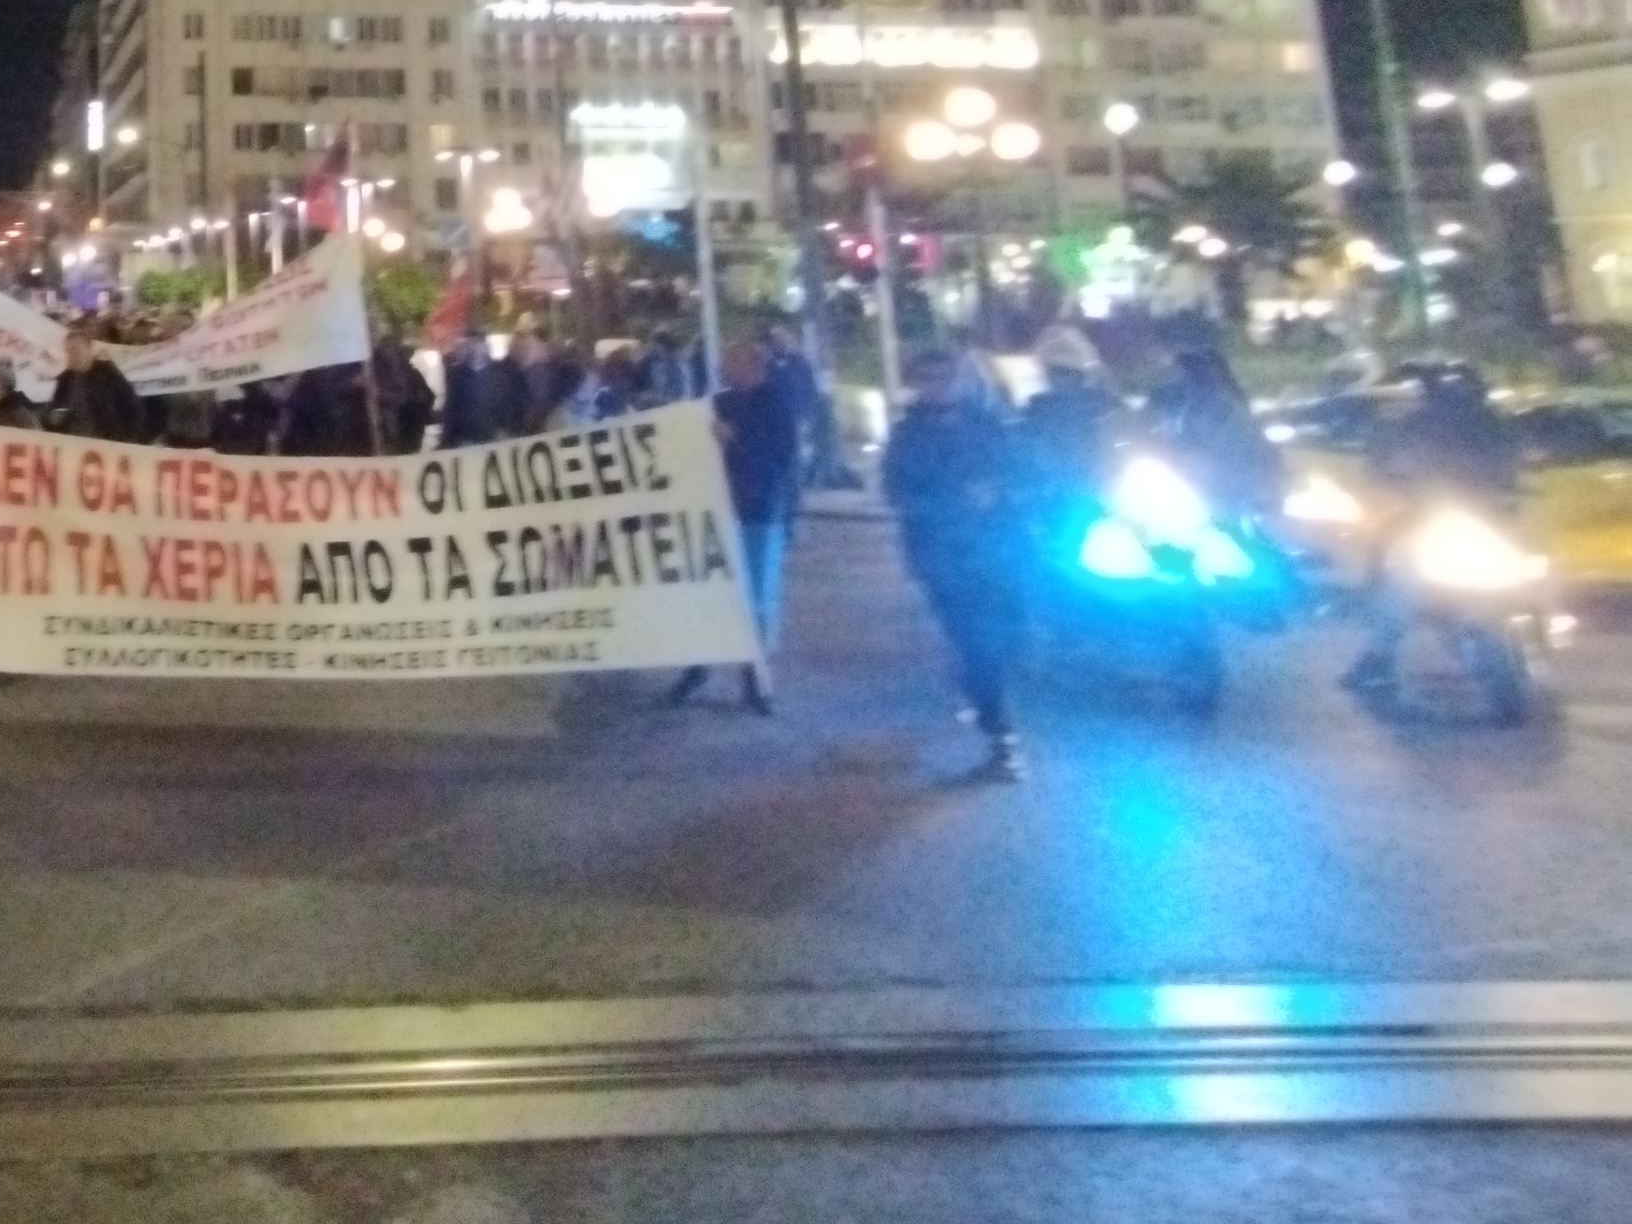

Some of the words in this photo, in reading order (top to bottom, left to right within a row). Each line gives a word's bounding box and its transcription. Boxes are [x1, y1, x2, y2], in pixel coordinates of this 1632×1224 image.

[78, 449, 137, 516] ΘΑ
[154, 458, 401, 524] ΠΕΡΑΣΟΥΝ
[417, 458, 464, 515] ΟΙ
[483, 422, 670, 510] ΔΙΩΞΕΙΣ
[66, 530, 126, 597] ΤΑ
[140, 536, 281, 605] ΧΕΡΙΑ
[295, 538, 393, 605] ΑΠΟ
[407, 534, 473, 602] ΤΑ
[485, 509, 736, 598] ΣΩΜΑΤΕΙΑ
